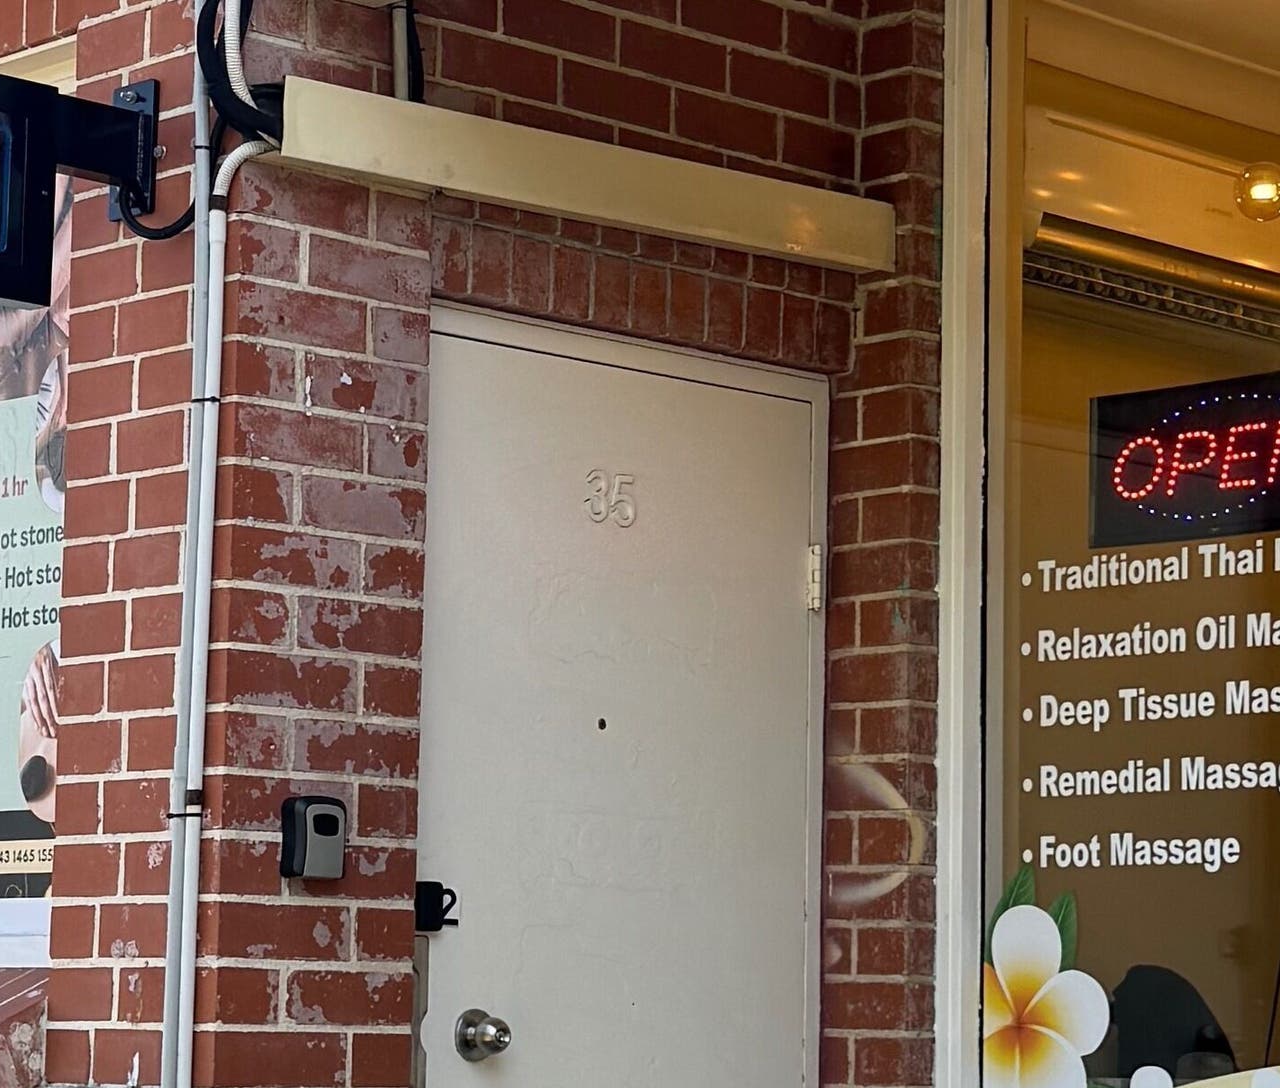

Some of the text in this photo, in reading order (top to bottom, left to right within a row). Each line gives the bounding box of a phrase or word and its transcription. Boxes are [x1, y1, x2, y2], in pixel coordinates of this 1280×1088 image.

[1, 477, 9, 498] 1
[12, 475, 28, 496] hr
[583, 468, 638, 528] 35
[20, 524, 63, 547] stone
[5, 566, 33, 588] Hot
[1038, 547, 1188, 592] Traditional
[1198, 540, 1264, 578] Thai
[1, 606, 29, 629] Hot
[1037, 622, 1186, 662] Relaxation
[1196, 614, 1236, 651] Oil
[1039, 694, 1110, 732] Deep
[1118, 687, 1216, 724] Tissue
[1039, 757, 1170, 797] Remedial
[1039, 832, 1240, 873] Foot Massage
